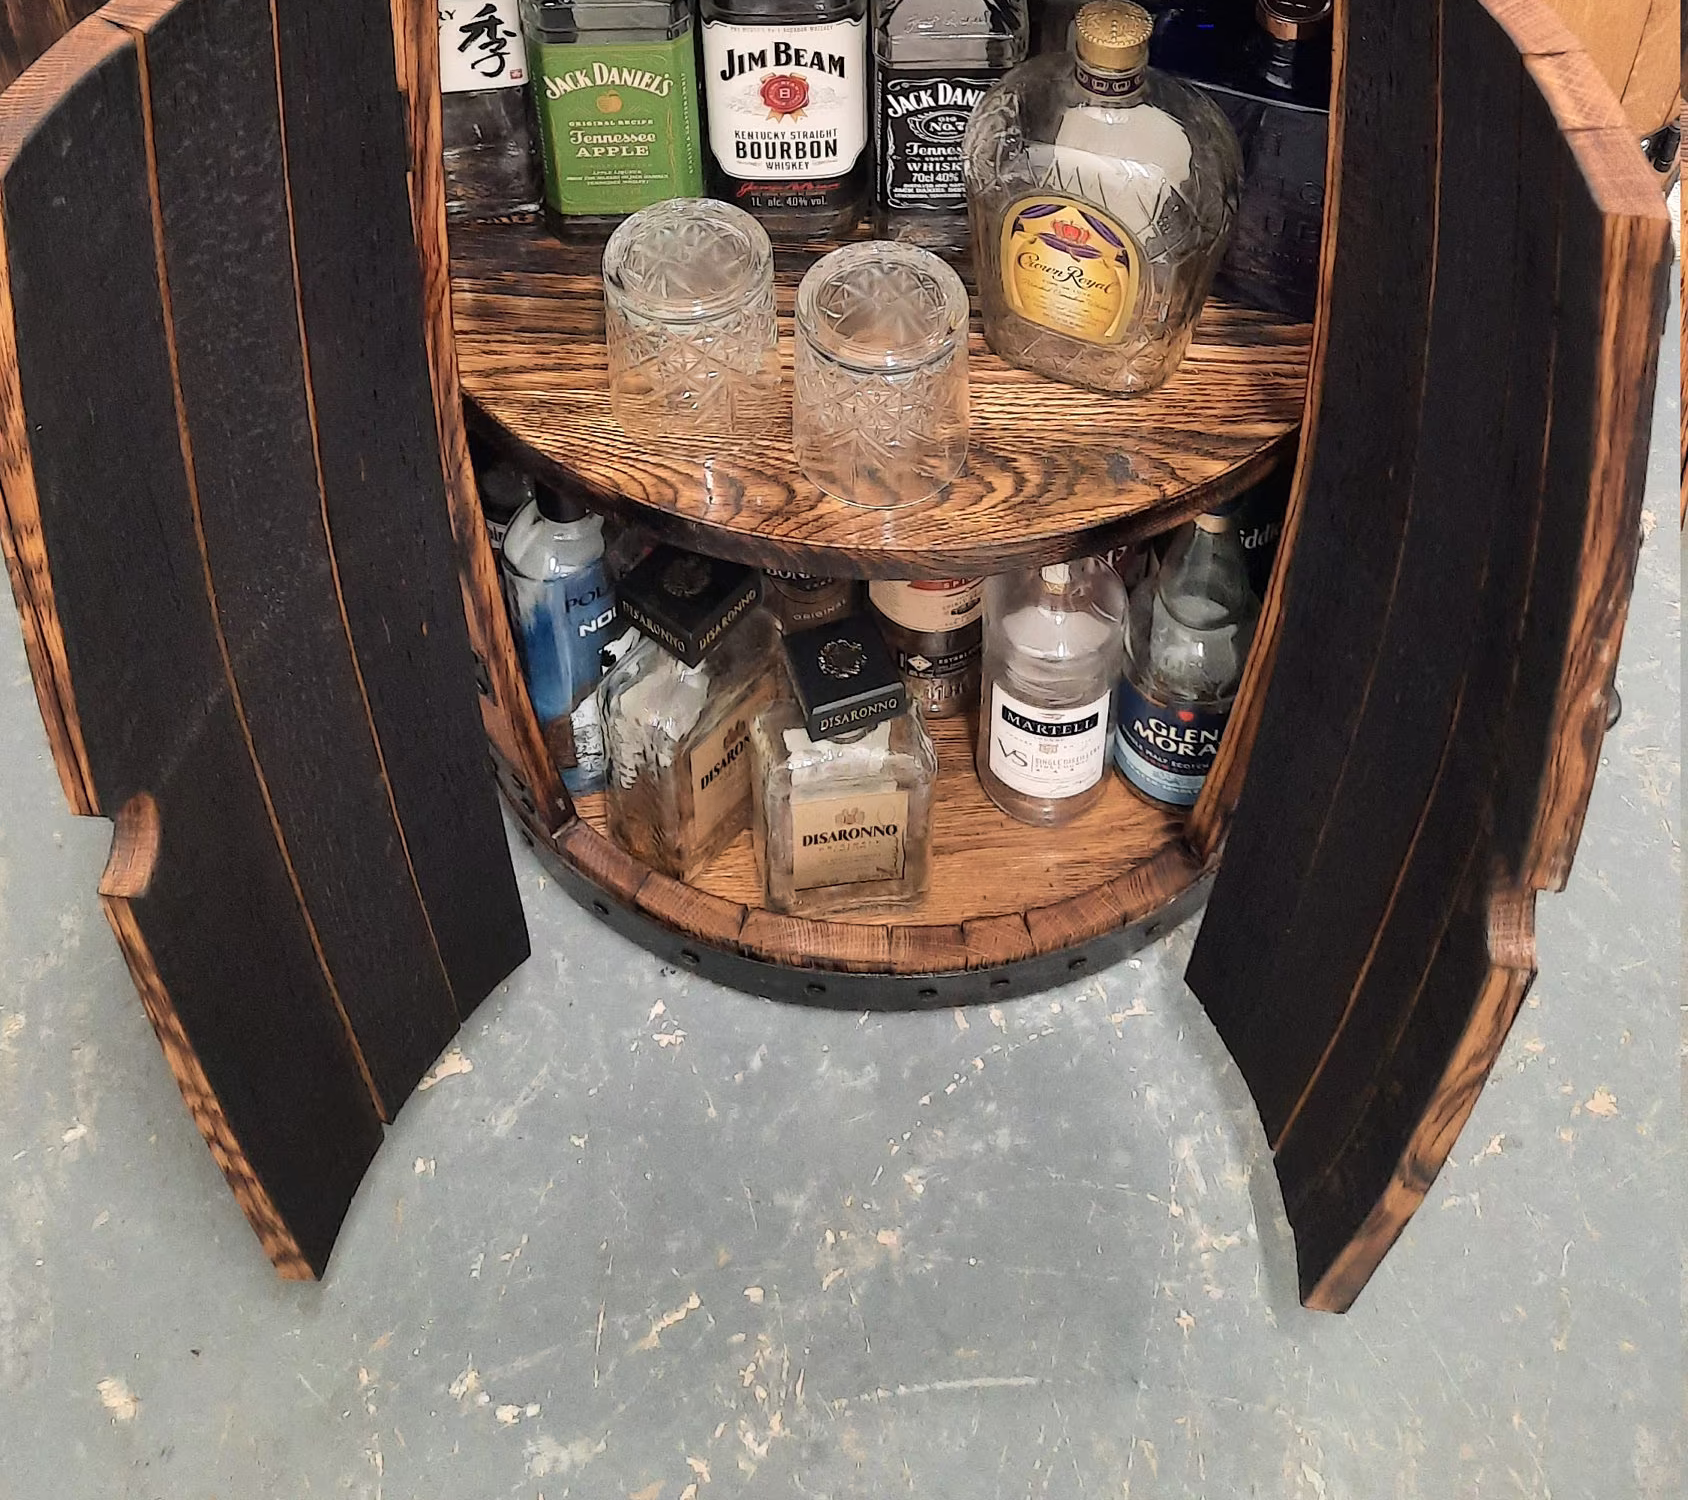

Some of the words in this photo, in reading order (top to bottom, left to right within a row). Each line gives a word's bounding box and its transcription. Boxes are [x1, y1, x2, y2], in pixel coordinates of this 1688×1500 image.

[720, 49, 768, 82] JIM
[772, 41, 846, 79] BEAM
[542, 68, 595, 100] JACK
[592, 61, 674, 97] DANIEL'S
[886, 89, 936, 118] JACK
[568, 119, 616, 127] ORIGINAL
[734, 130, 786, 140] KENTUCKY
[790, 128, 838, 140] STRAIGHT
[569, 130, 657, 145] Tennessee
[735, 138, 838, 160] BOURBON
[575, 145, 650, 158] APPLE
[765, 161, 810, 171] WHISKEY
[912, 172, 934, 182] 70cl
[935, 172, 959, 182] 40%
[751, 197, 762, 207] 1L
[786, 196, 808, 207] 40%
[1017, 251, 1063, 277] Crown
[1052, 265, 1112, 294] Royal
[622, 600, 686, 653] DISARONNO
[699, 589, 756, 650] DISARONNO
[819, 699, 898, 732] DISARONNO
[1006, 710, 1094, 736] MARTELL
[1148, 718, 1219, 744] GLEN
[998, 736, 1028, 767] VS
[802, 823, 898, 847] DISARONNO
